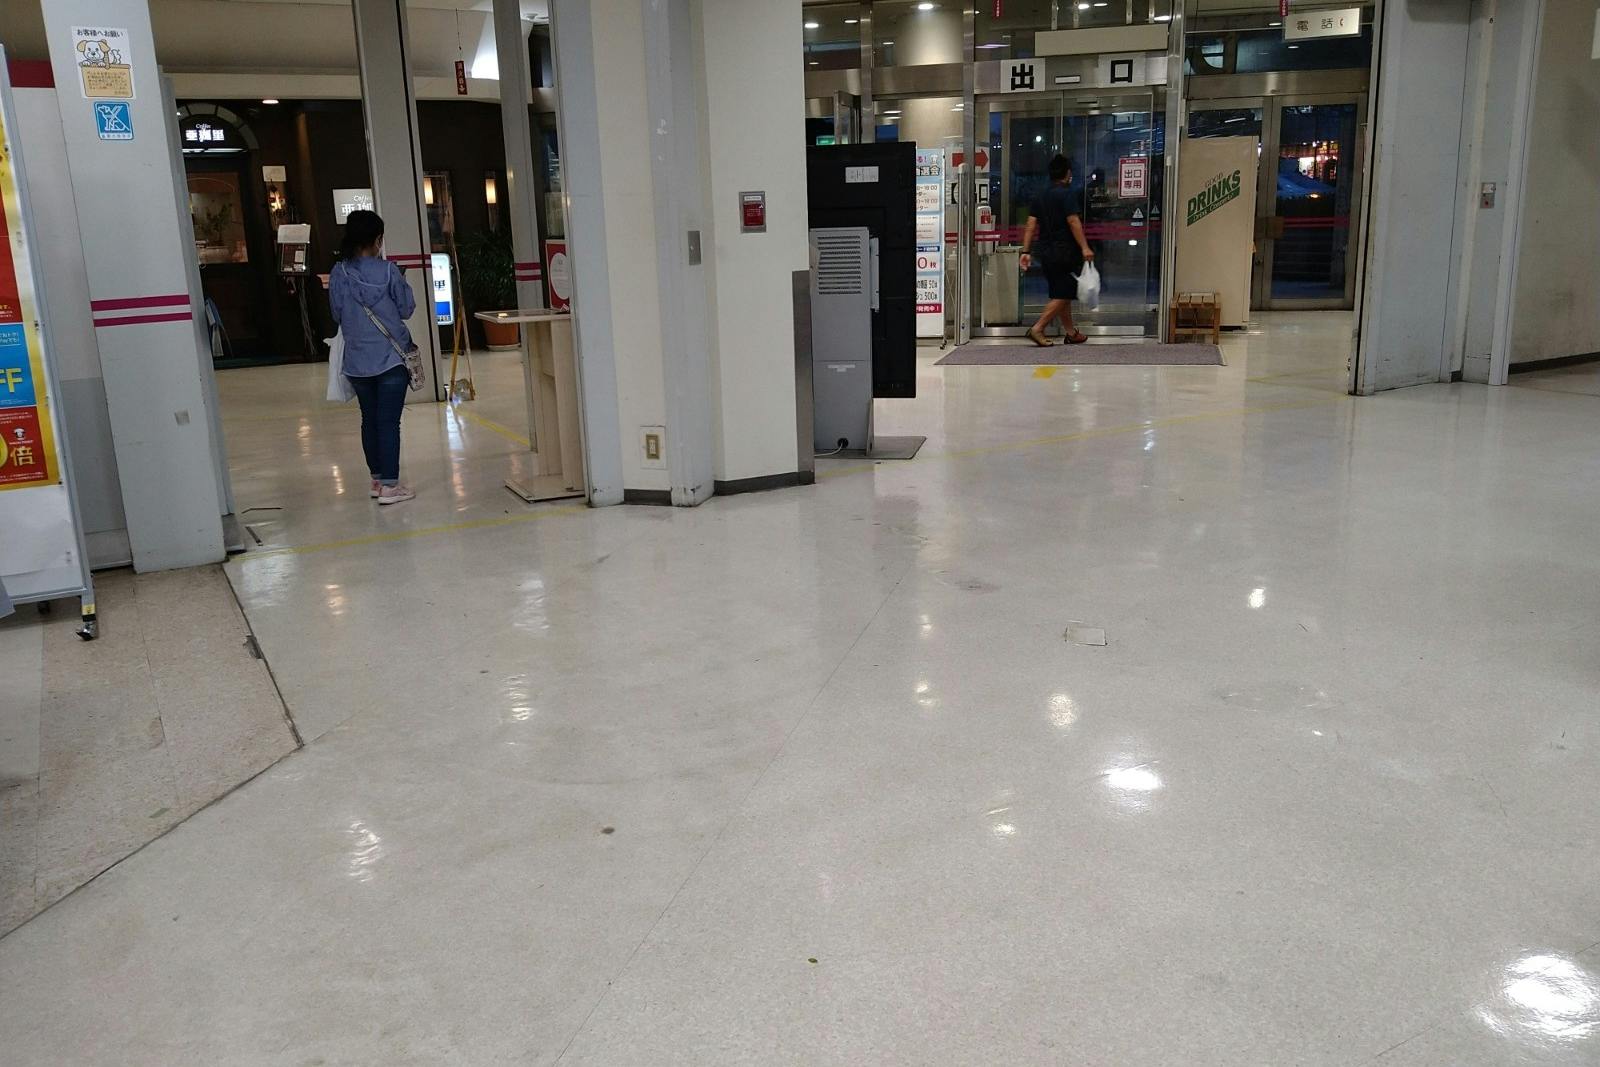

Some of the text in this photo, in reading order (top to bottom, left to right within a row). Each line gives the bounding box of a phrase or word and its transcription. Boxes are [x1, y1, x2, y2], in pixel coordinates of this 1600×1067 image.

[1297, 17, 1333, 31] 電話
[77, 29, 124, 38] お客様へお願い
[1124, 169, 1142, 178] 出口
[1187, 169, 1241, 218] DRINKS
[10, 446, 36, 467] 倍
